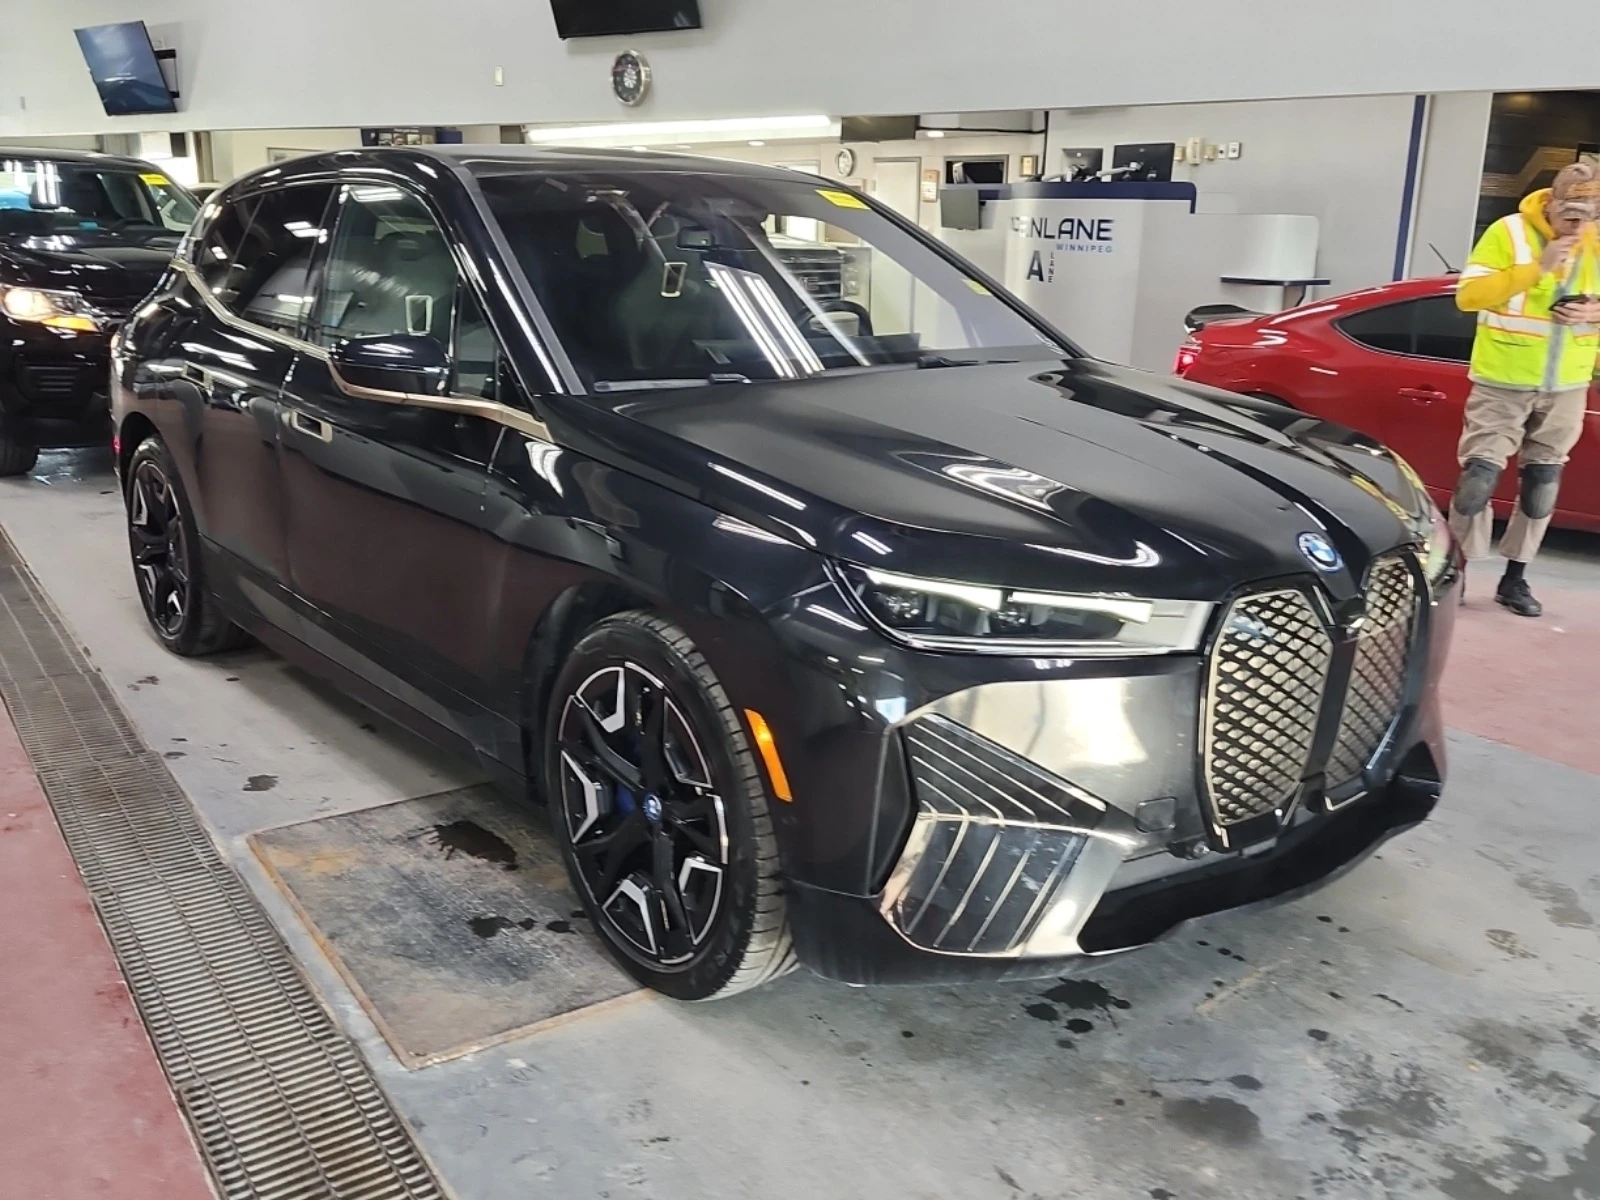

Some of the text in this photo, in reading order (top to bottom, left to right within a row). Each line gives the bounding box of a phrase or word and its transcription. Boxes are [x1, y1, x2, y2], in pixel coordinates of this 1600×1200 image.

[1056, 242, 1112, 253] WINNIPEG
[1026, 250, 1055, 283] A LANE
